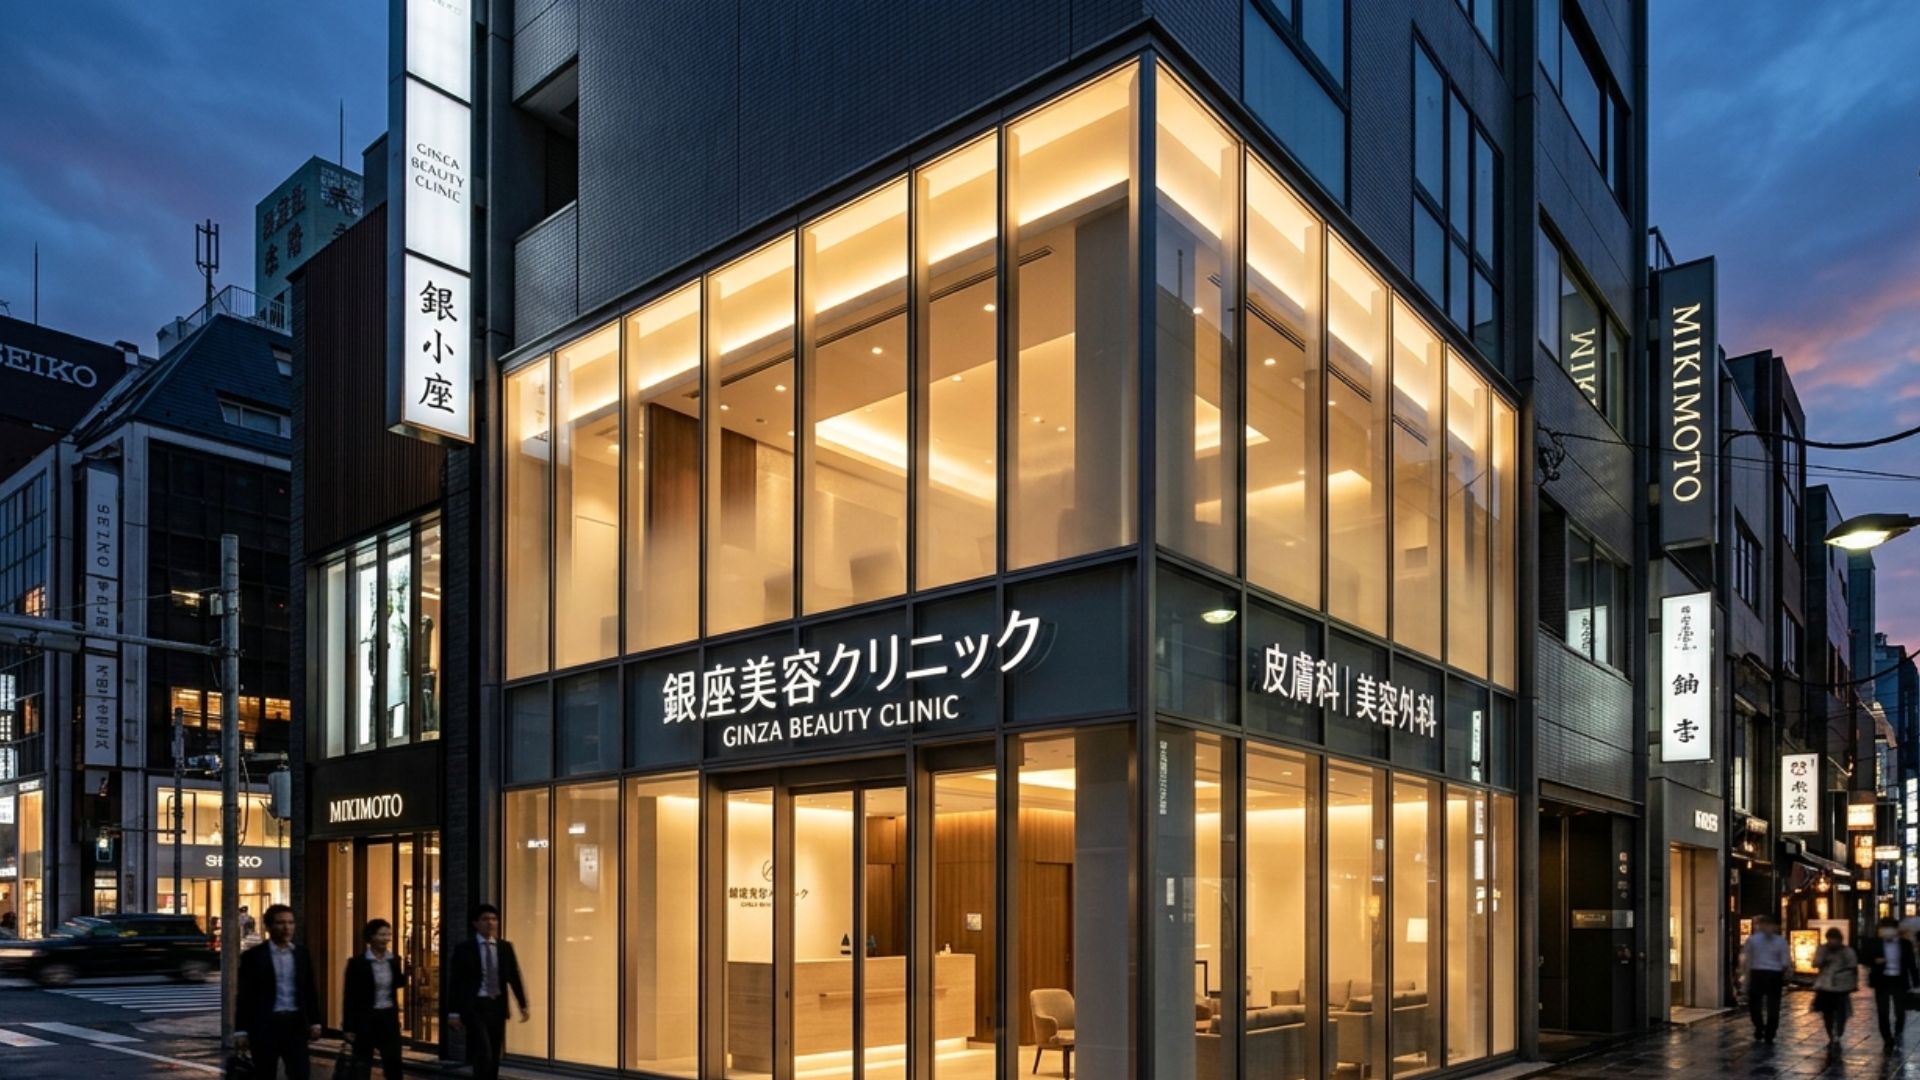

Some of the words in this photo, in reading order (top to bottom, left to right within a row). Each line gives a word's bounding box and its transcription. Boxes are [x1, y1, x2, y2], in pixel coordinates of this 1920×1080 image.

[415, 174, 461, 203] CLINIC
[0, 343, 97, 388] EIKO
[419, 280, 458, 413] 銀小座
[1672, 302, 1702, 502] MIKIMOTO
[662, 610, 1040, 724] 銀座美容クリニック
[723, 719, 783, 748] GINZA
[789, 707, 872, 739] BEAUTY
[879, 694, 960, 728] CLINIC
[205, 854, 262, 868] SKO
